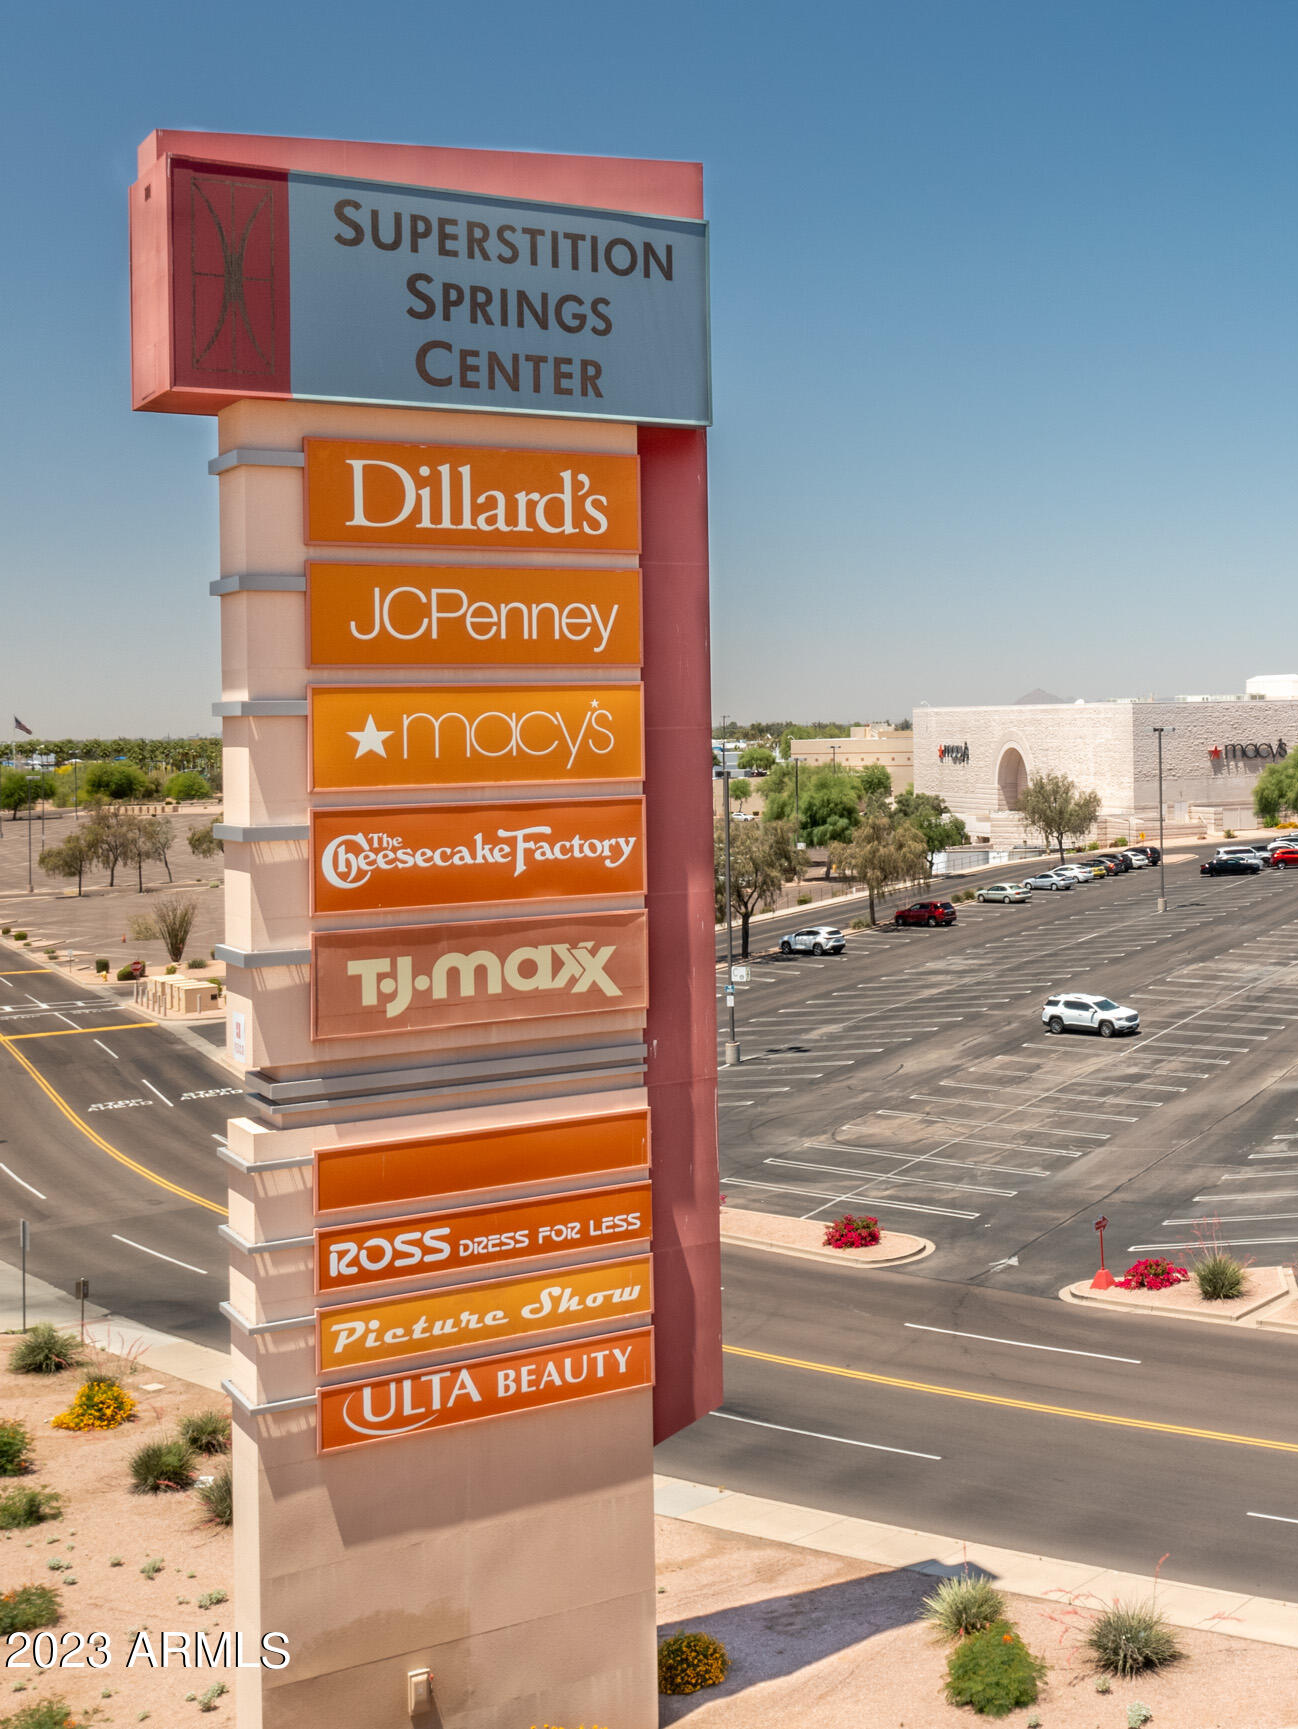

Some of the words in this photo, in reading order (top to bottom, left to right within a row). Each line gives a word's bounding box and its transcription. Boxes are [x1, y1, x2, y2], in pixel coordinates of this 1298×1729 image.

[333, 198, 674, 281] SUPERSTITION
[405, 272, 614, 337] SPRINGS
[414, 340, 604, 399] CENTER
[345, 459, 609, 536] Dillard's
[349, 586, 619, 653] JCPenney
[402, 698, 615, 770] macy's
[1224, 738, 1288, 762] macy's
[321, 832, 513, 890] Cheesecake
[497, 826, 637, 878] Factory
[369, 832, 404, 850] The
[329, 1227, 451, 1277] ROSS
[459, 1230, 529, 1257] DRESS
[538, 1222, 581, 1245] FOR
[589, 1212, 641, 1234] LESS
[330, 1306, 510, 1355] Picture
[520, 1286, 641, 1319] Show
[361, 1368, 482, 1423] ULTA
[497, 1345, 633, 1399] BEAUTY
